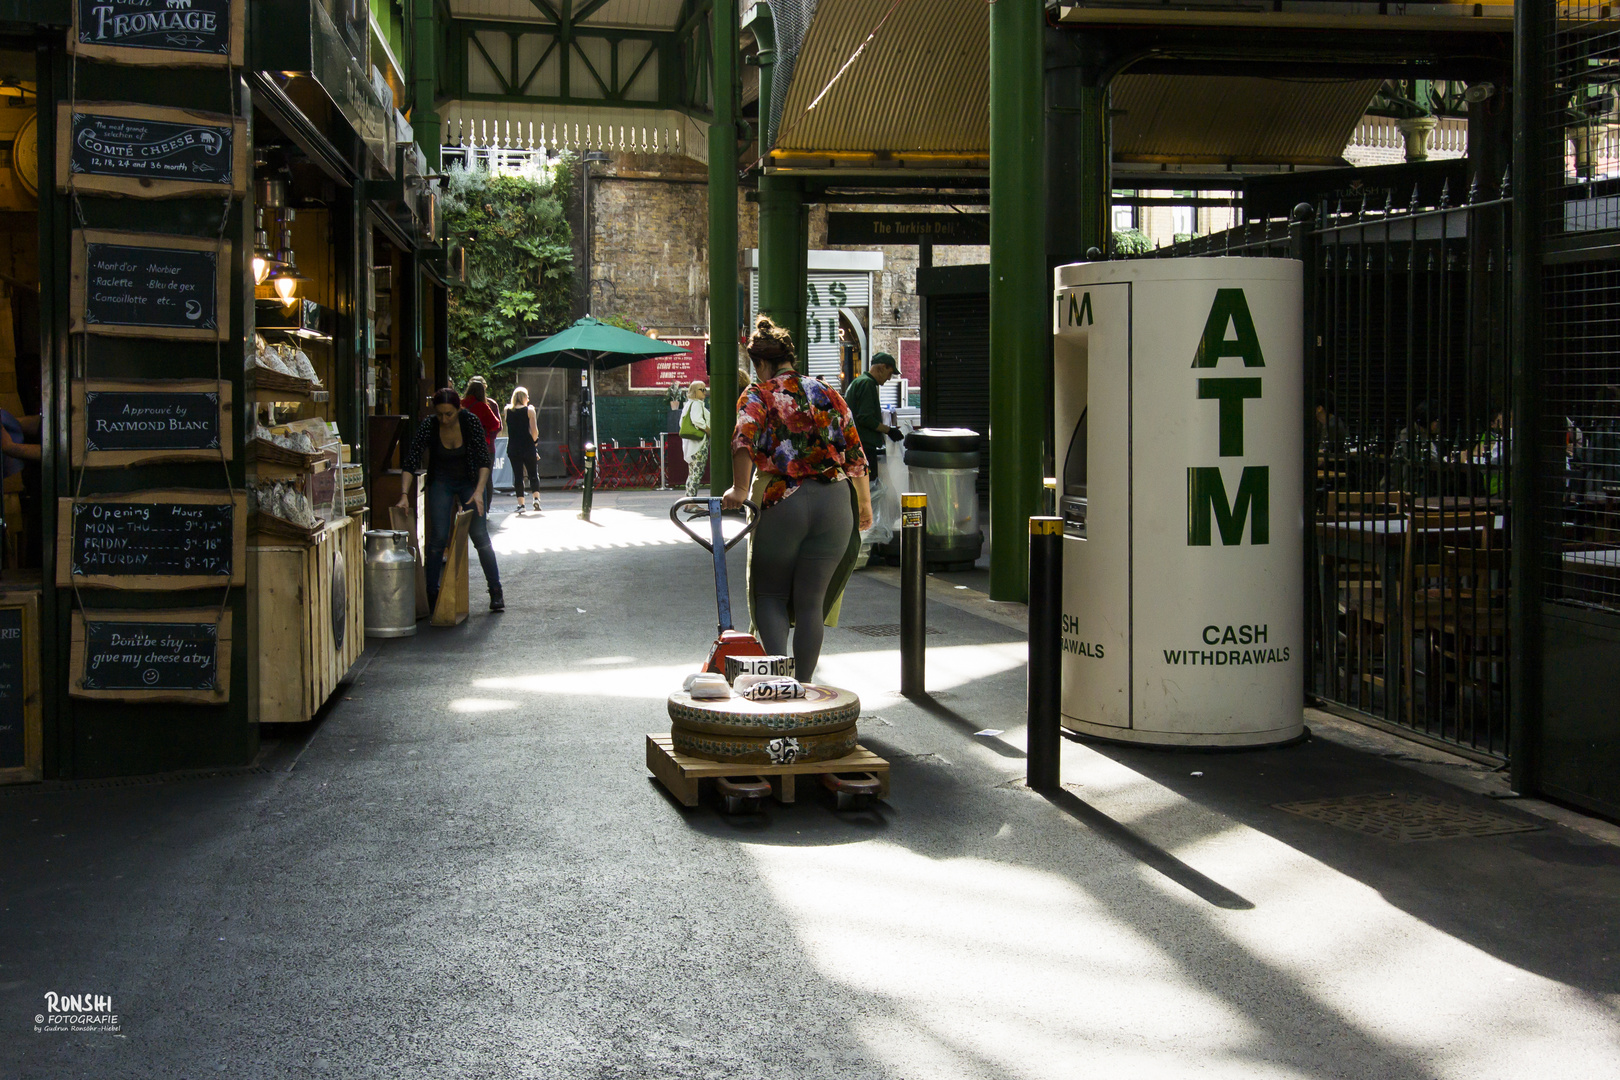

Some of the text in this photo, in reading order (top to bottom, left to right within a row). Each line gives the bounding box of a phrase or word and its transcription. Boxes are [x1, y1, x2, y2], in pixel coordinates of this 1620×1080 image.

[92, 6, 217, 40] FROMAGE
[95, 121, 107, 129] The
[108, 123, 124, 131] most
[104, 131, 145, 141] selection of
[84, 133, 195, 157] COMTÉ CHEESE
[118, 159, 130, 167] 24
[150, 161, 162, 169] 36
[873, 221, 954, 234] The Turkish Deli
[97, 261, 119, 271] Mont
[148, 263, 181, 275] Morbier
[96, 276, 133, 288] Raclette
[148, 279, 166, 289] Bleu
[167, 280, 178, 290] de
[175, 405, 188, 417] by
[1187, 288, 1269, 546] ATM
[96, 418, 209, 433] RAYMOND BLANC
[92, 505, 203, 521] Opening Hours
[143, 634, 157, 647] be
[1202, 624, 1268, 645] CASH
[91, 651, 211, 669] give my cheese a try
[1163, 646, 1290, 666] WITHDRAWALS
